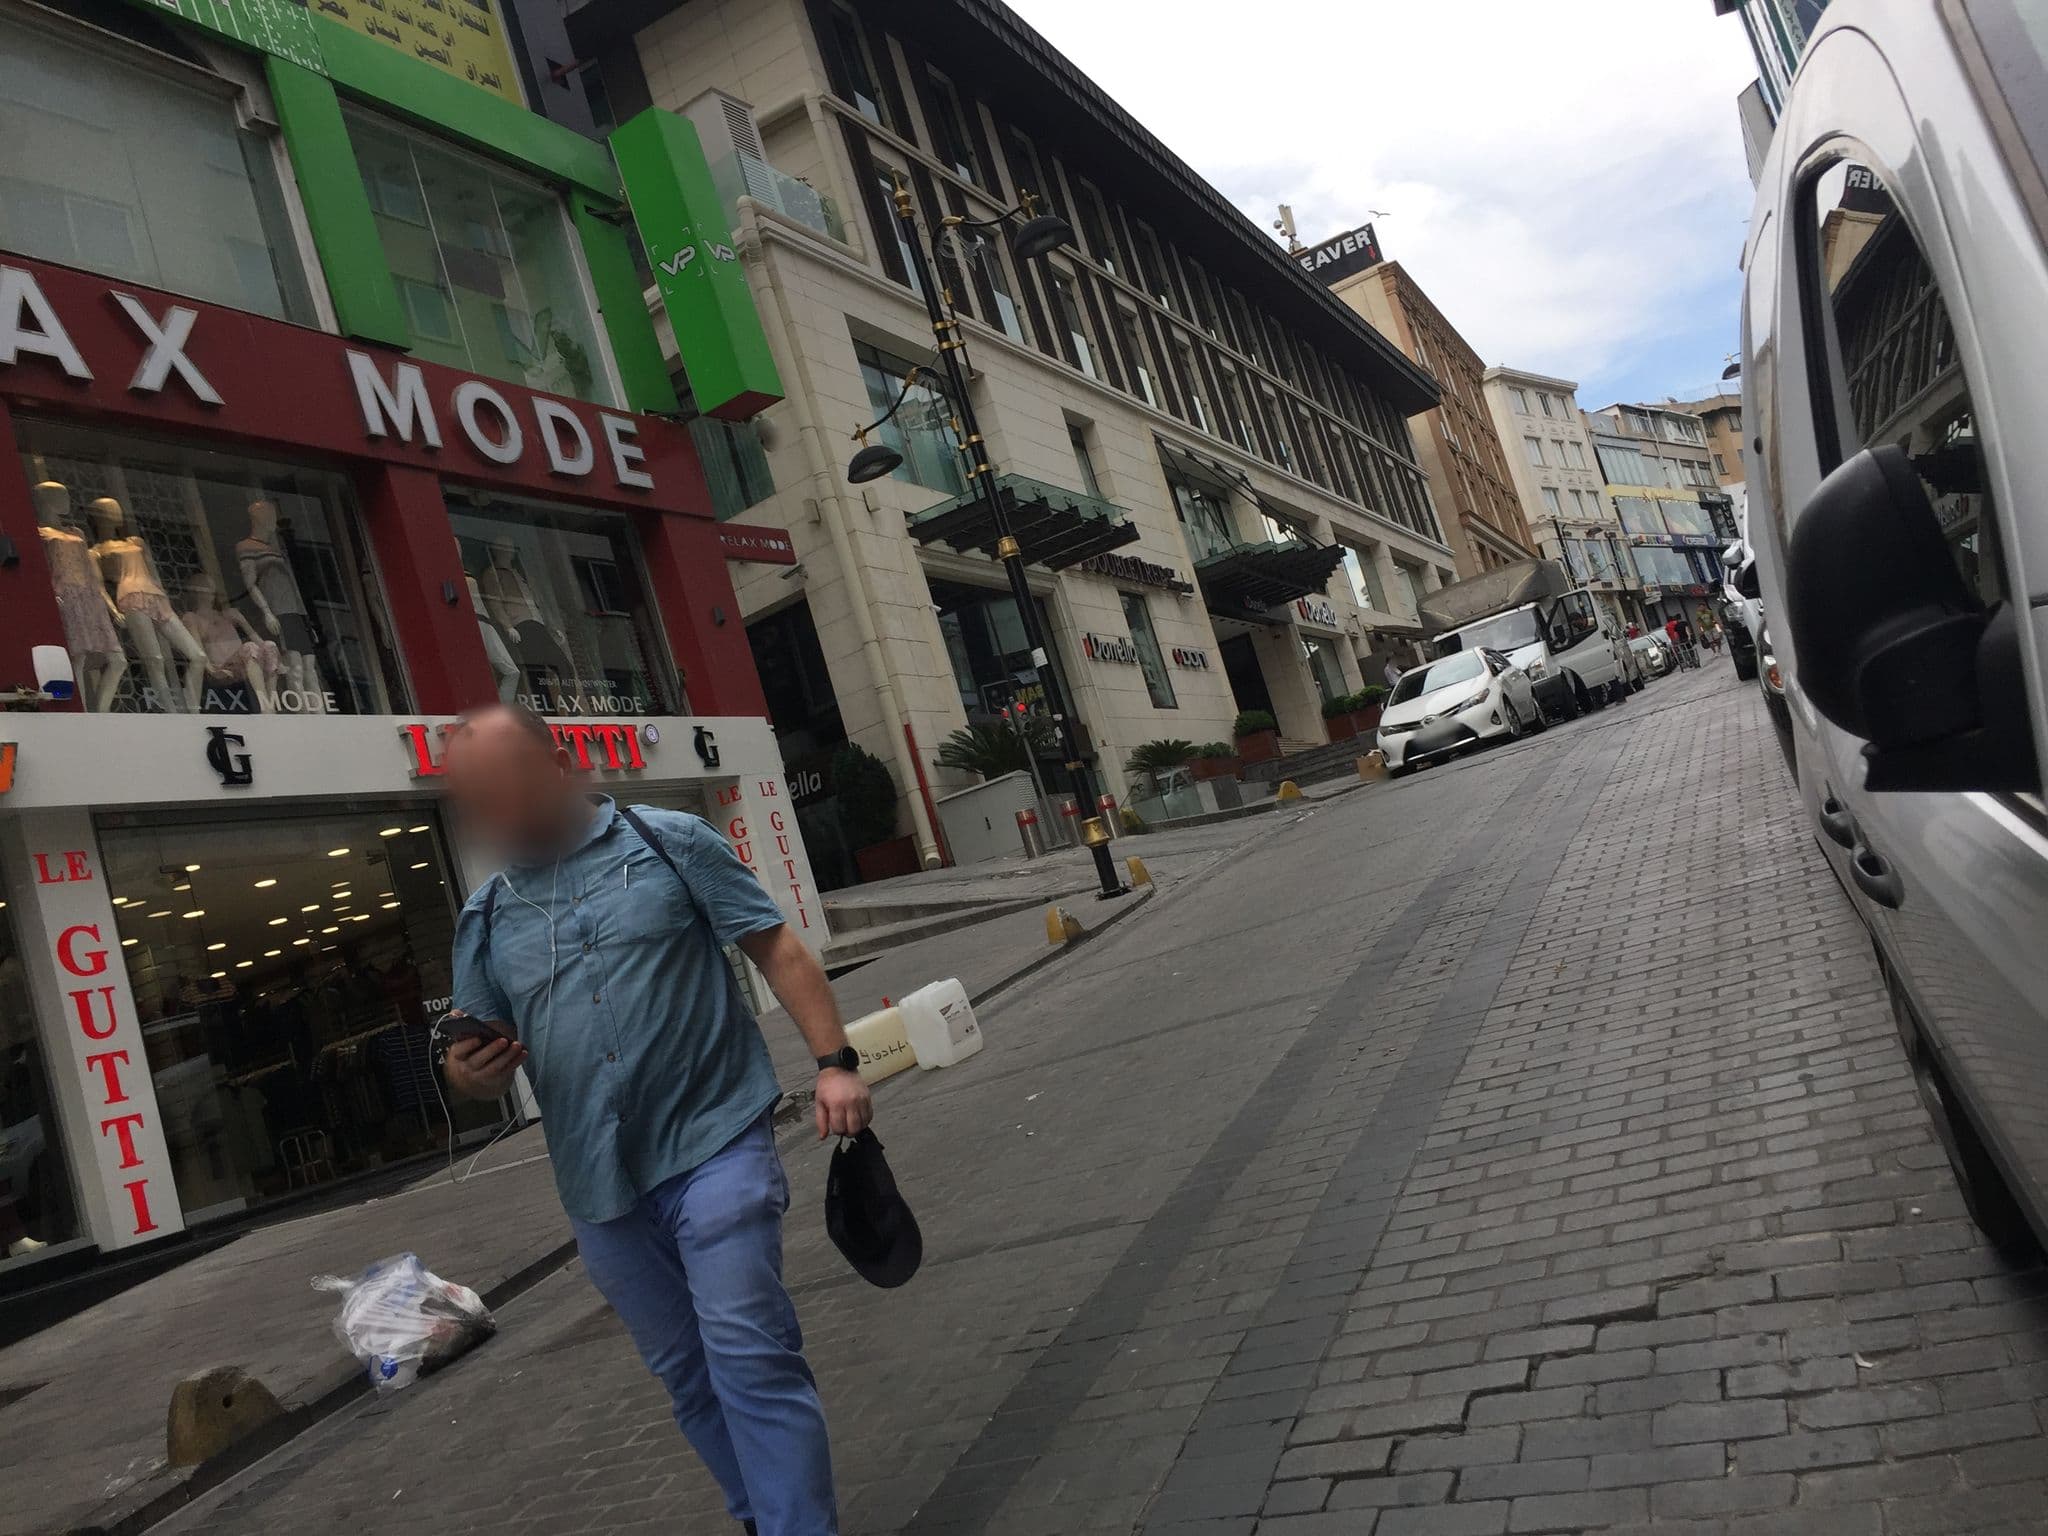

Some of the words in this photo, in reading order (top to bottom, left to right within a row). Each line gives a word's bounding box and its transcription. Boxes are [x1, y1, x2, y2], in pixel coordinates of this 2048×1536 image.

[658, 245, 696, 277] VP
[1300, 230, 1371, 272] EAVER
[345, 348, 655, 490] MODE
[720, 535, 758, 549] RELAX
[759, 538, 792, 551] MODE
[257, 690, 340, 712] MODE
[517, 694, 585, 712] RELAX
[591, 695, 646, 713] MODE
[716, 786, 741, 806] LE
[759, 781, 777, 797] LE
[33, 851, 93, 884] LE
[771, 811, 808, 928] GUTTI
[57, 924, 158, 1235] GUTTI
